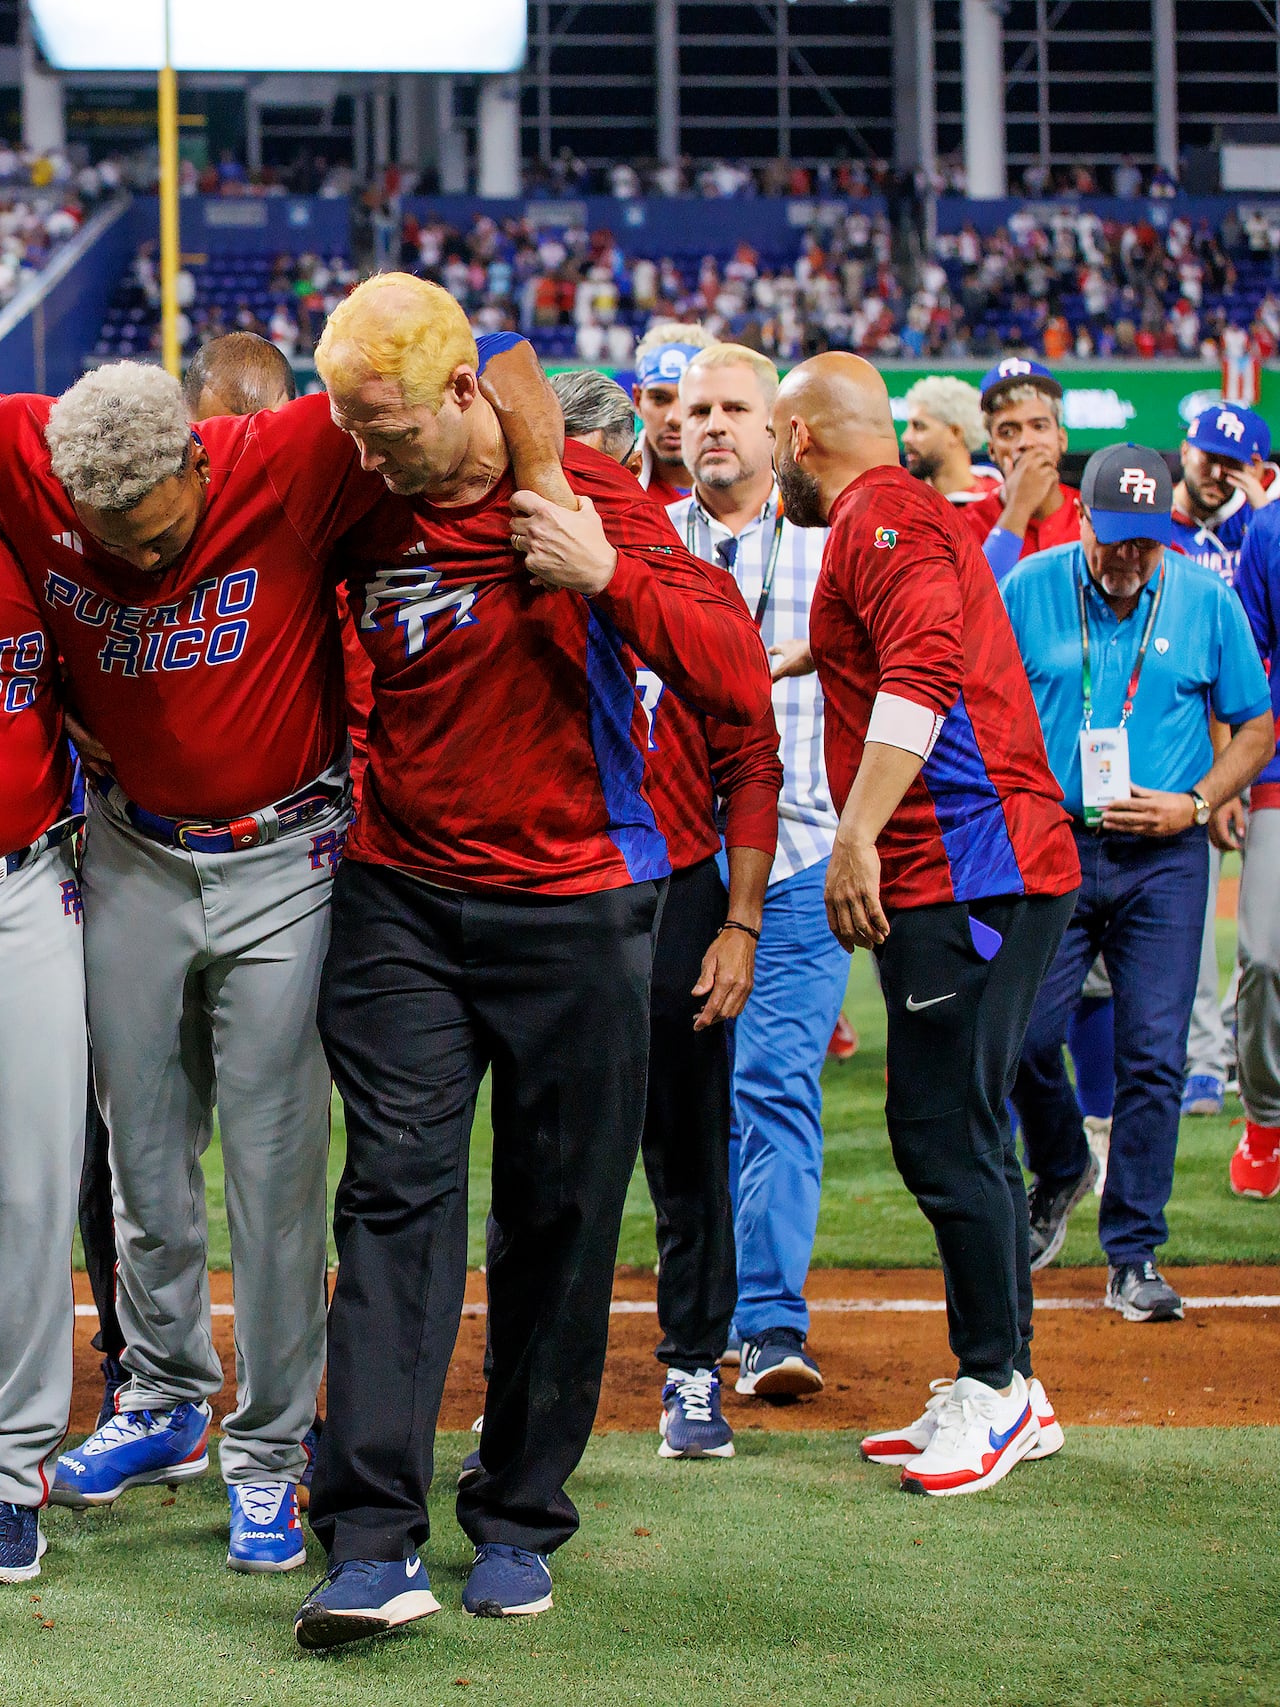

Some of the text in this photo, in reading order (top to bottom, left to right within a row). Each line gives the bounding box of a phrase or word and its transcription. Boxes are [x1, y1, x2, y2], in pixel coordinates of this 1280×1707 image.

[1119, 467, 1157, 505] PR
[97, 618, 250, 678] RICO
[239, 1531, 286, 1541] SUGAR
